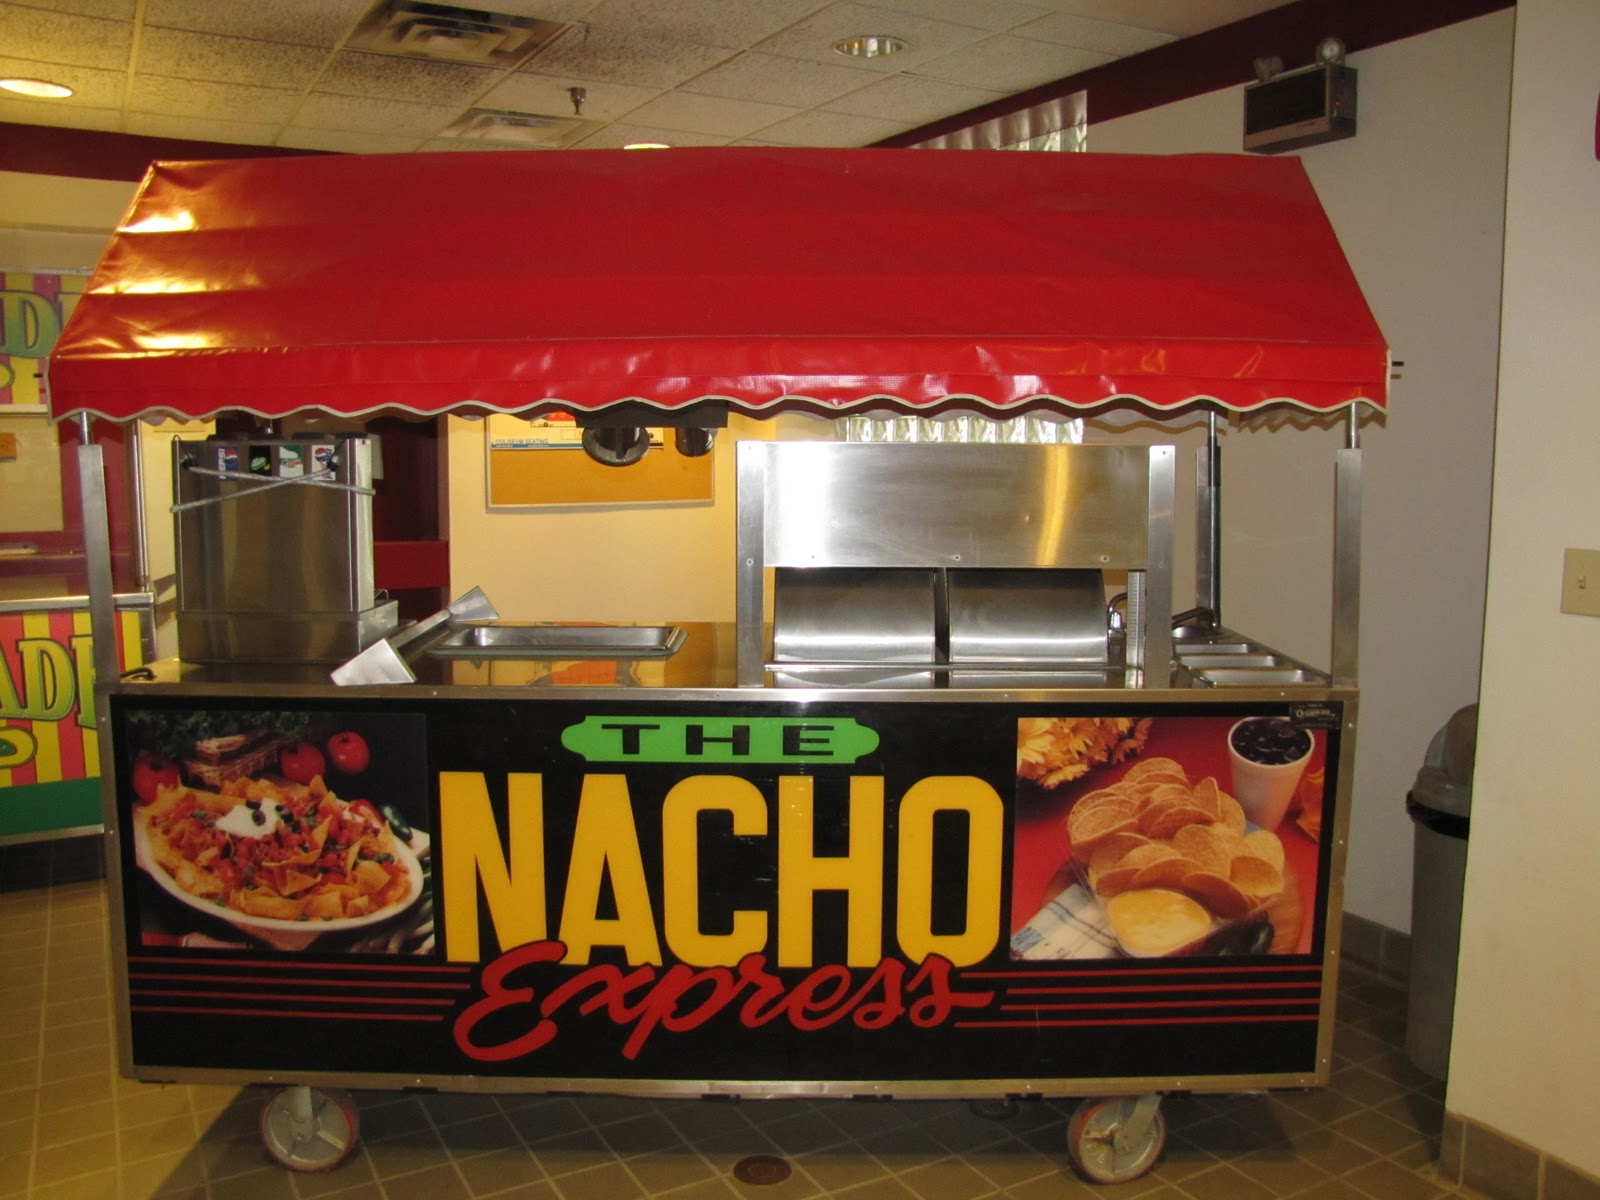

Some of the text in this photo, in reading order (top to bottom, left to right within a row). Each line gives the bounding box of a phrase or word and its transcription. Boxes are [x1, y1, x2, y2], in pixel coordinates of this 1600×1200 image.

[602, 724, 835, 756] THE
[439, 771, 1004, 968] NACHO
[453, 940, 994, 1061] Express
